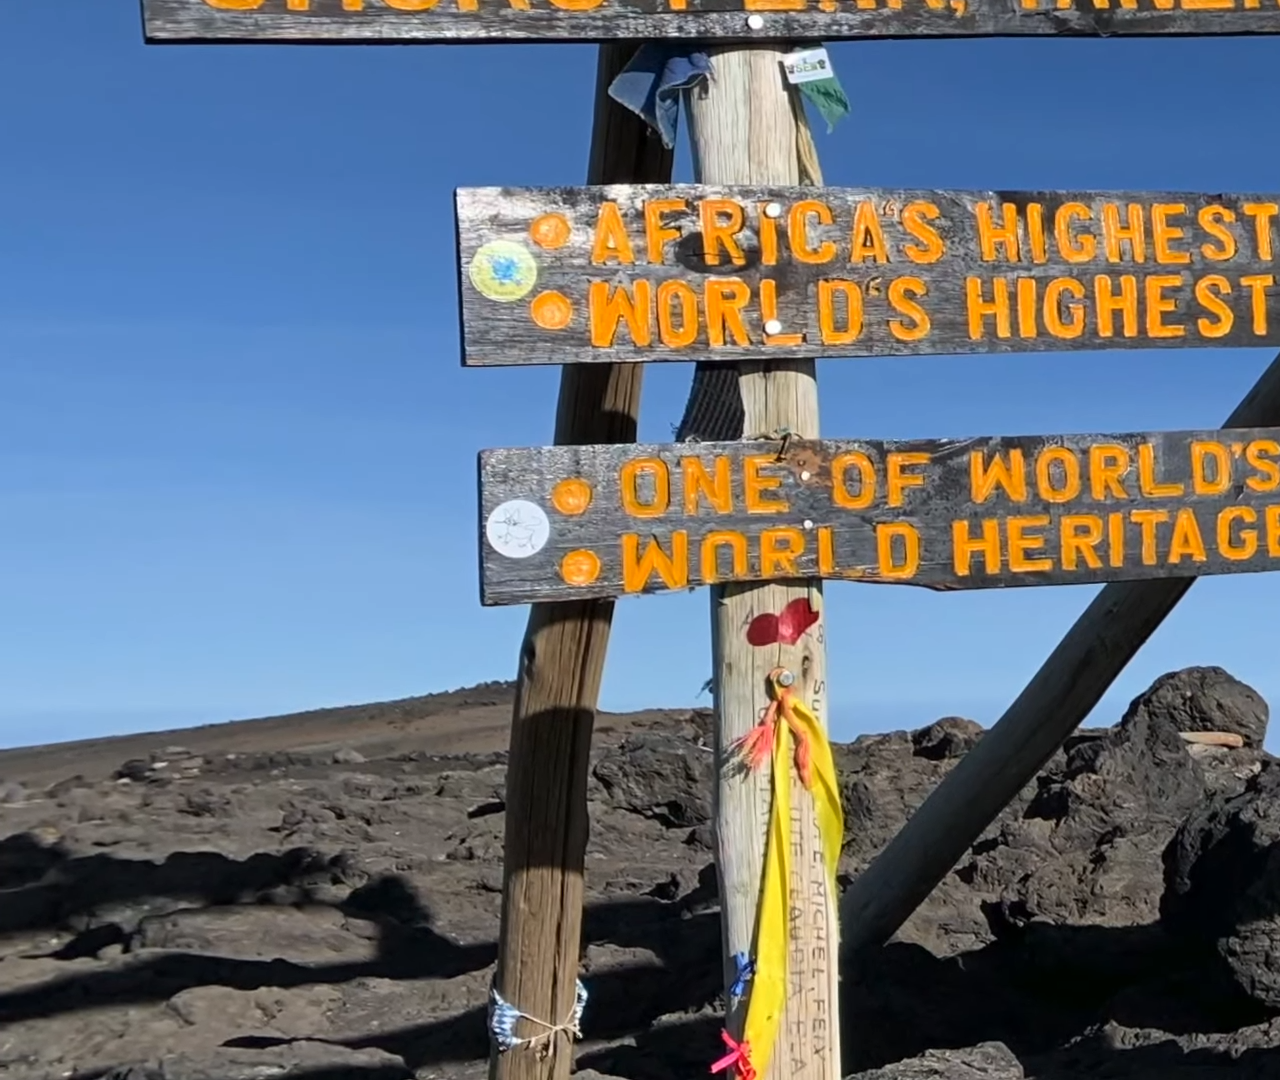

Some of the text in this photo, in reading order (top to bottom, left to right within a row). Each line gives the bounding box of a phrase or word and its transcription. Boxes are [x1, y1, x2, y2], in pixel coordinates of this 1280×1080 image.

[593, 200, 945, 265] AFRICA'S
[977, 203, 1276, 264] HIGHEST
[591, 277, 930, 348] WORLD'S
[966, 275, 1273, 339] HIGHEST
[620, 454, 786, 516] ONE
[830, 452, 929, 509] OF
[971, 440, 1280, 502] WORLD'S
